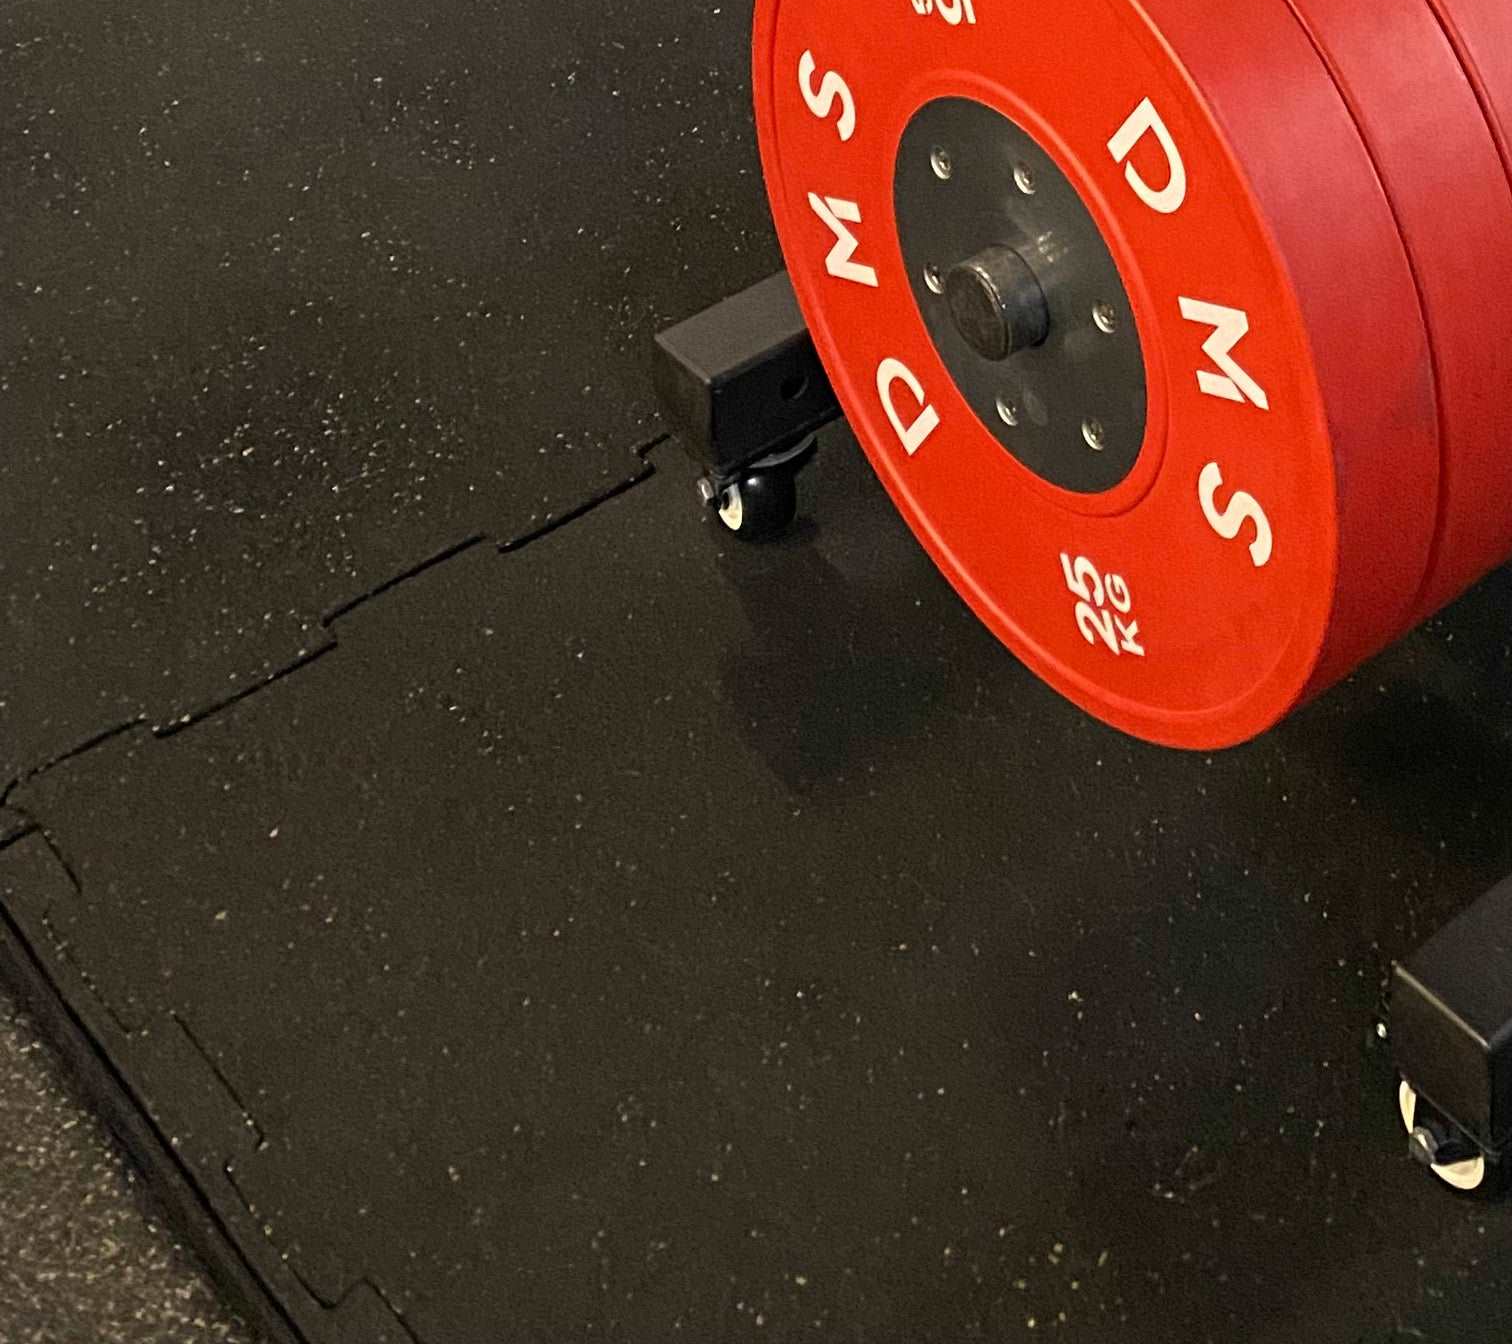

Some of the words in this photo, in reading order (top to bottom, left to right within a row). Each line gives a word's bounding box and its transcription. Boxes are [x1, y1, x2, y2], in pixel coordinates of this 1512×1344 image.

[798, 49, 940, 457] DMS
[1106, 96, 1272, 567] DMS
[1060, 552, 1121, 657] 25
[1109, 572, 1146, 658] KG
